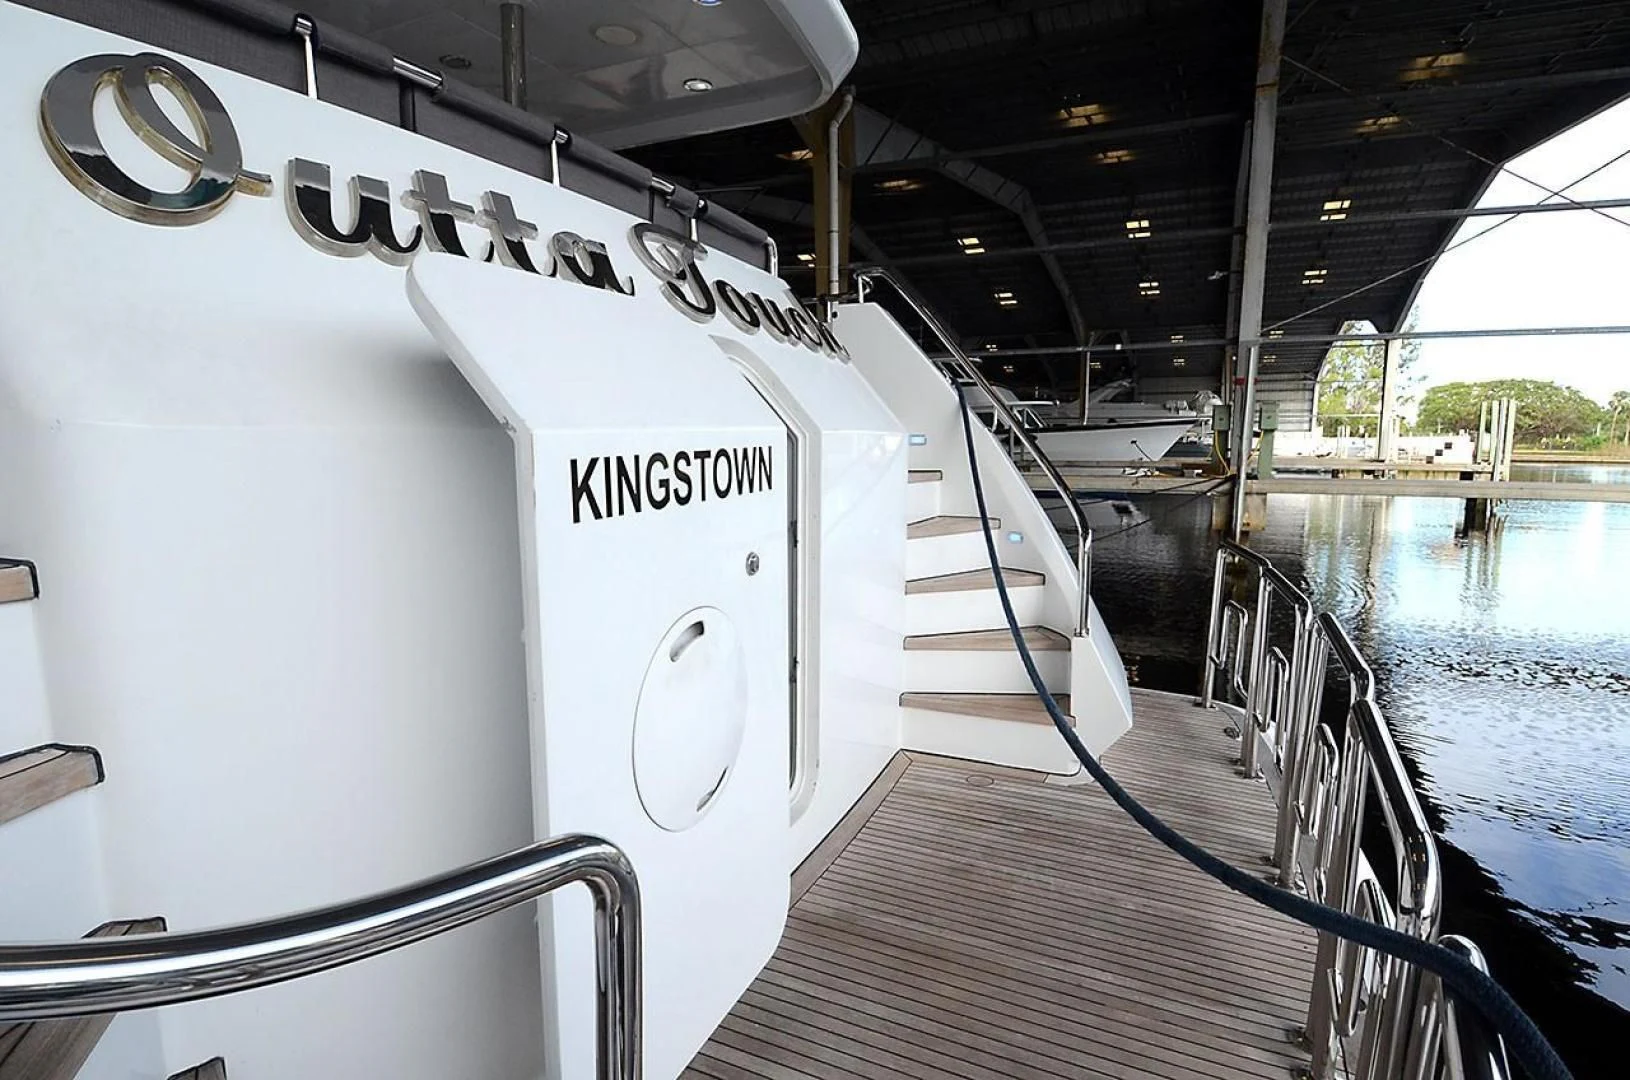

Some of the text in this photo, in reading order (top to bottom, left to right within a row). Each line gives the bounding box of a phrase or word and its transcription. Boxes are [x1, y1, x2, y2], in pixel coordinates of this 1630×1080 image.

[39, 52, 851, 364] Outta Touch
[570, 446, 773, 524] KINGSTOWN
